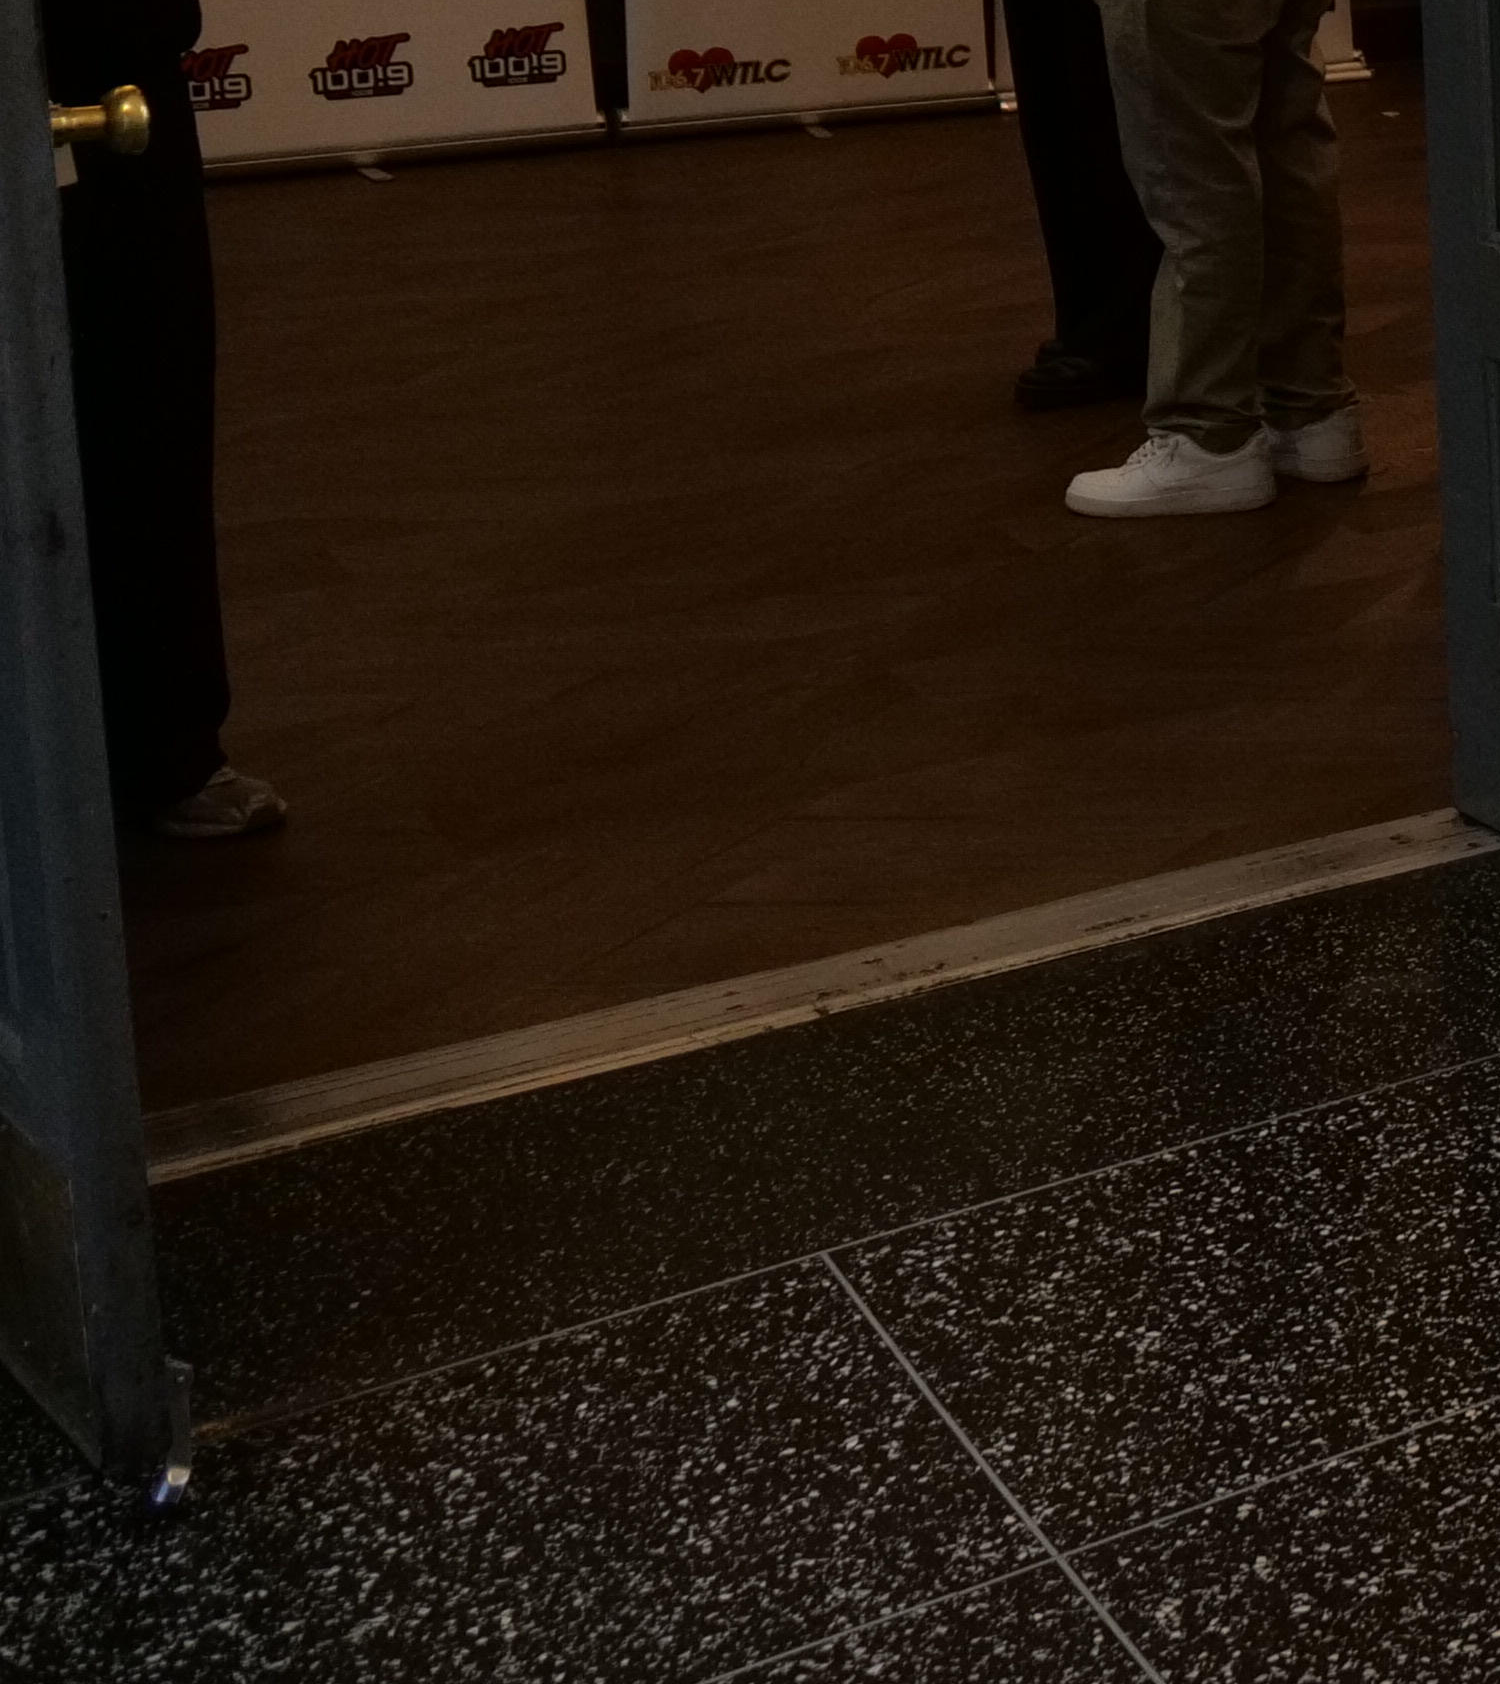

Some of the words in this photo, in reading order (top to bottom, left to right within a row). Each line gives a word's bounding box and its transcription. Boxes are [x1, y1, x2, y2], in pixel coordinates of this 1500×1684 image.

[327, 33, 410, 71] HOT
[485, 23, 564, 59] HOT
[648, 67, 706, 92] 106.7
[708, 59, 791, 87] WTLC
[836, 53, 892, 75] 106.7
[894, 45, 971, 72] WTLC
